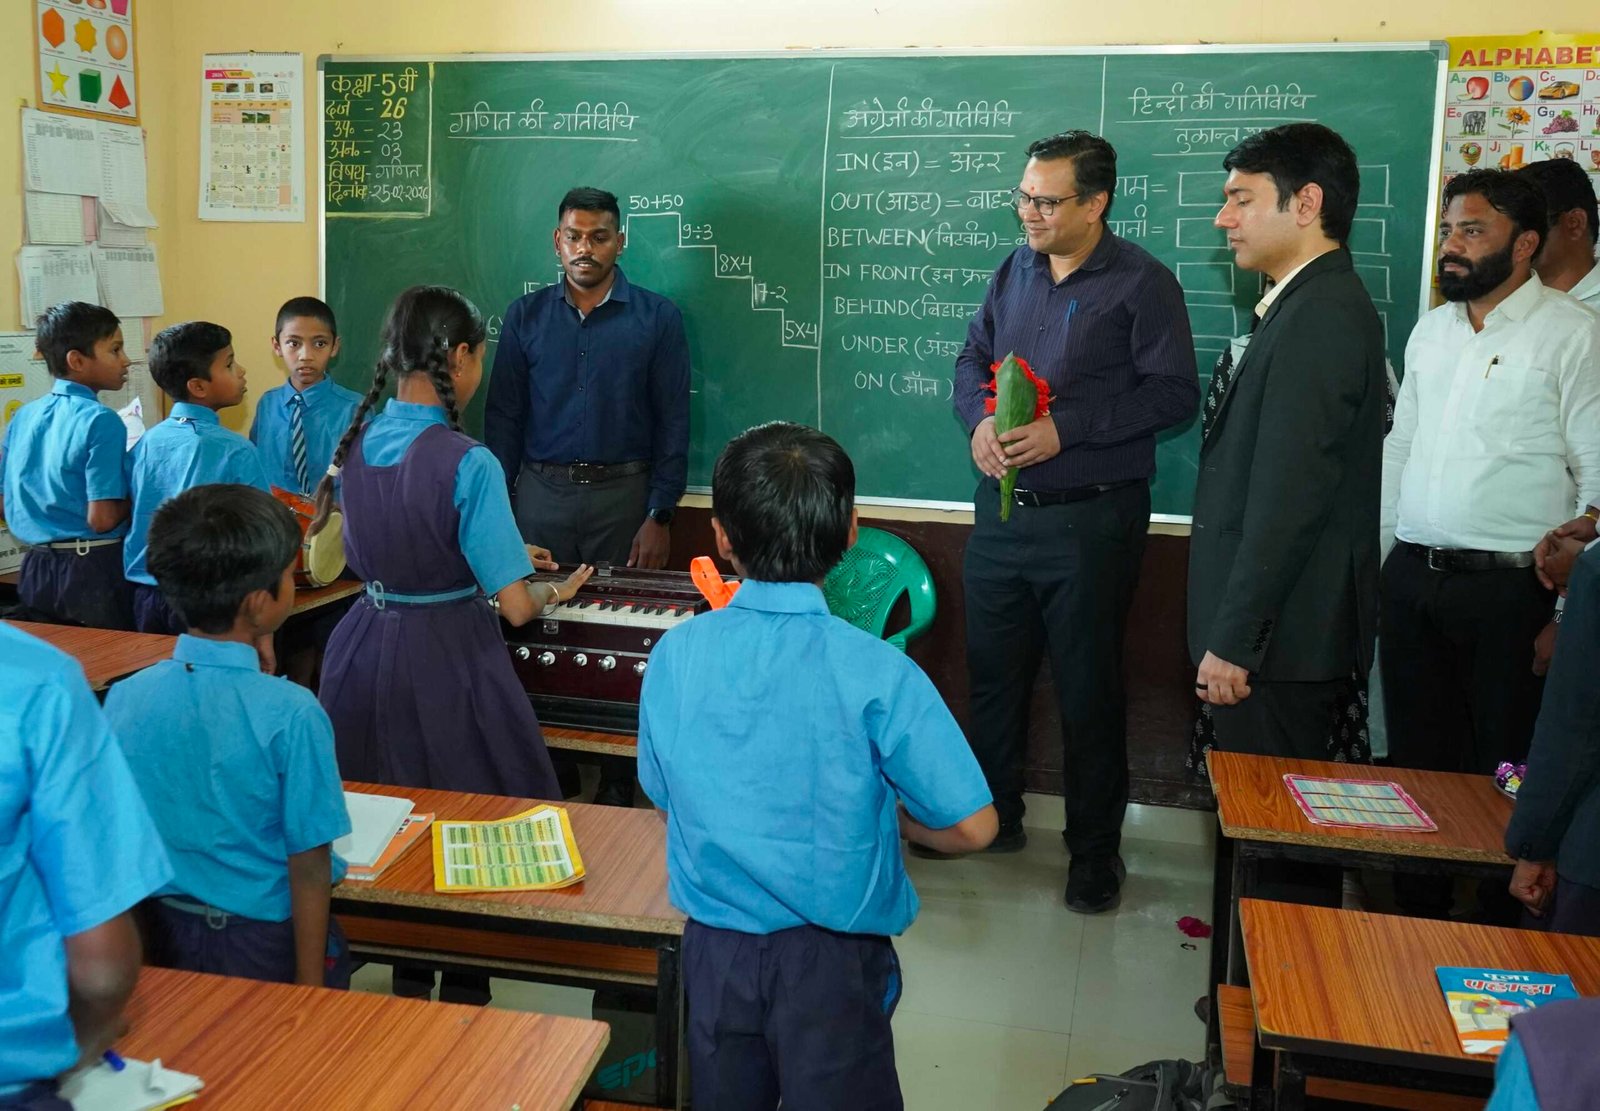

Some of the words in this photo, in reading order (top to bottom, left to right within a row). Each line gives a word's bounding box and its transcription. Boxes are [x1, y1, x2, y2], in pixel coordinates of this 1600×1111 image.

[380, 97, 408, 119] 26
[1190, 81, 1225, 110] की
[449, 101, 516, 132] गणित
[518, 98, 548, 129] की
[911, 97, 942, 127] की
[377, 121, 403, 141] 23
[381, 143, 402, 159] 03
